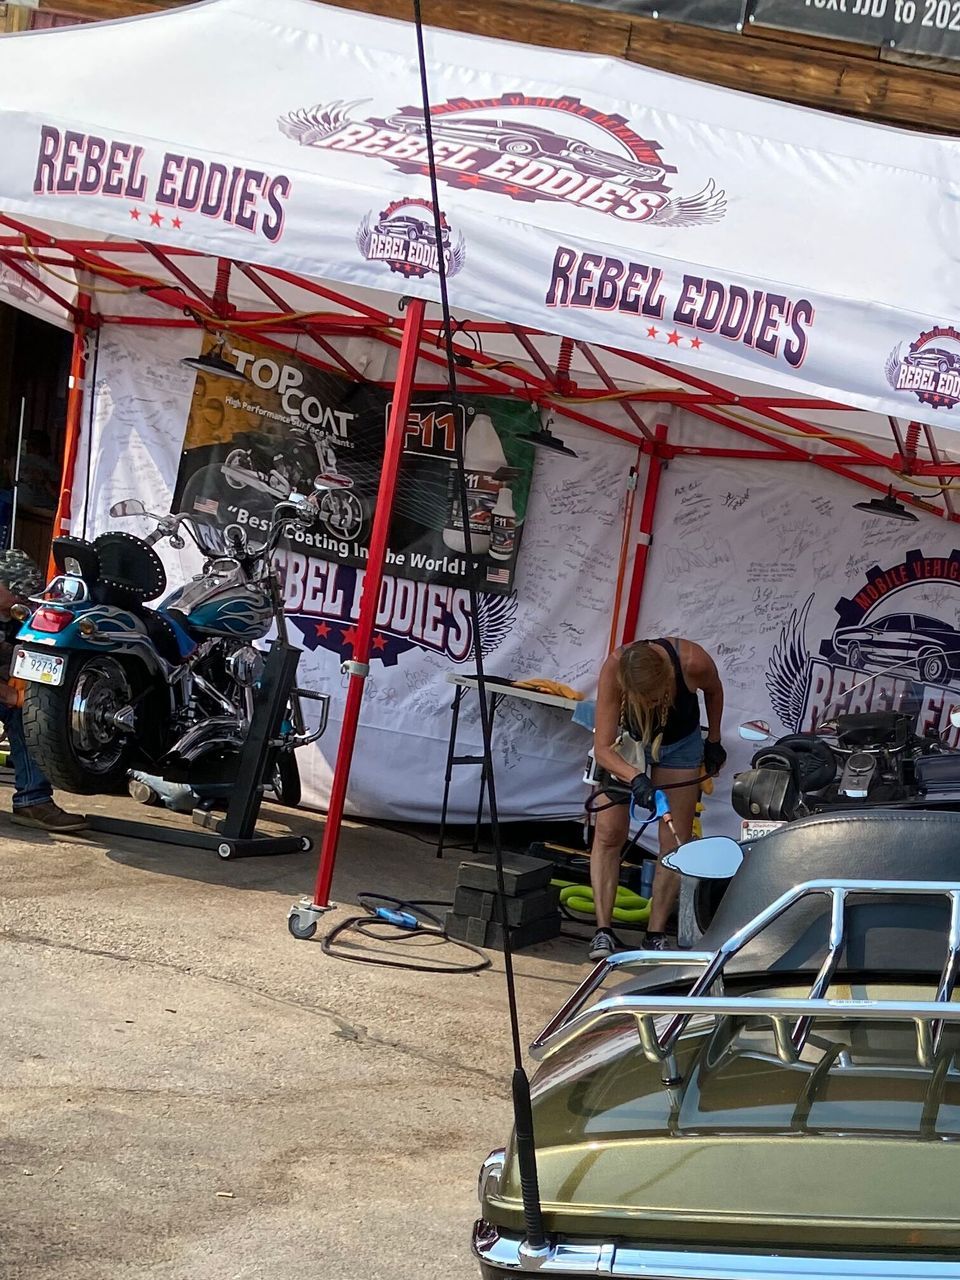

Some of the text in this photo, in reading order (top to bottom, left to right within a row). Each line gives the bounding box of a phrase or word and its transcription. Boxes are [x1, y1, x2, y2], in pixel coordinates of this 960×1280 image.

[805, 0, 847, 12] ext
[894, 0, 916, 24] to
[33, 124, 293, 243] REBEL EDDIE'S
[314, 121, 481, 172] REBEL
[479, 154, 670, 222] EDDIE'S
[368, 233, 451, 275] REBEL EDDIES
[546, 246, 815, 369] REBEL EDDIE'S
[232, 349, 304, 394] TOP
[896, 364, 936, 390] REBEL
[242, 402, 291, 424] Performance
[282, 387, 354, 438] COAT
[403, 411, 456, 452] F11
[386, 546, 405, 566] he
[271, 551, 344, 617] EBEL
[853, 564, 908, 611] MOBILE
